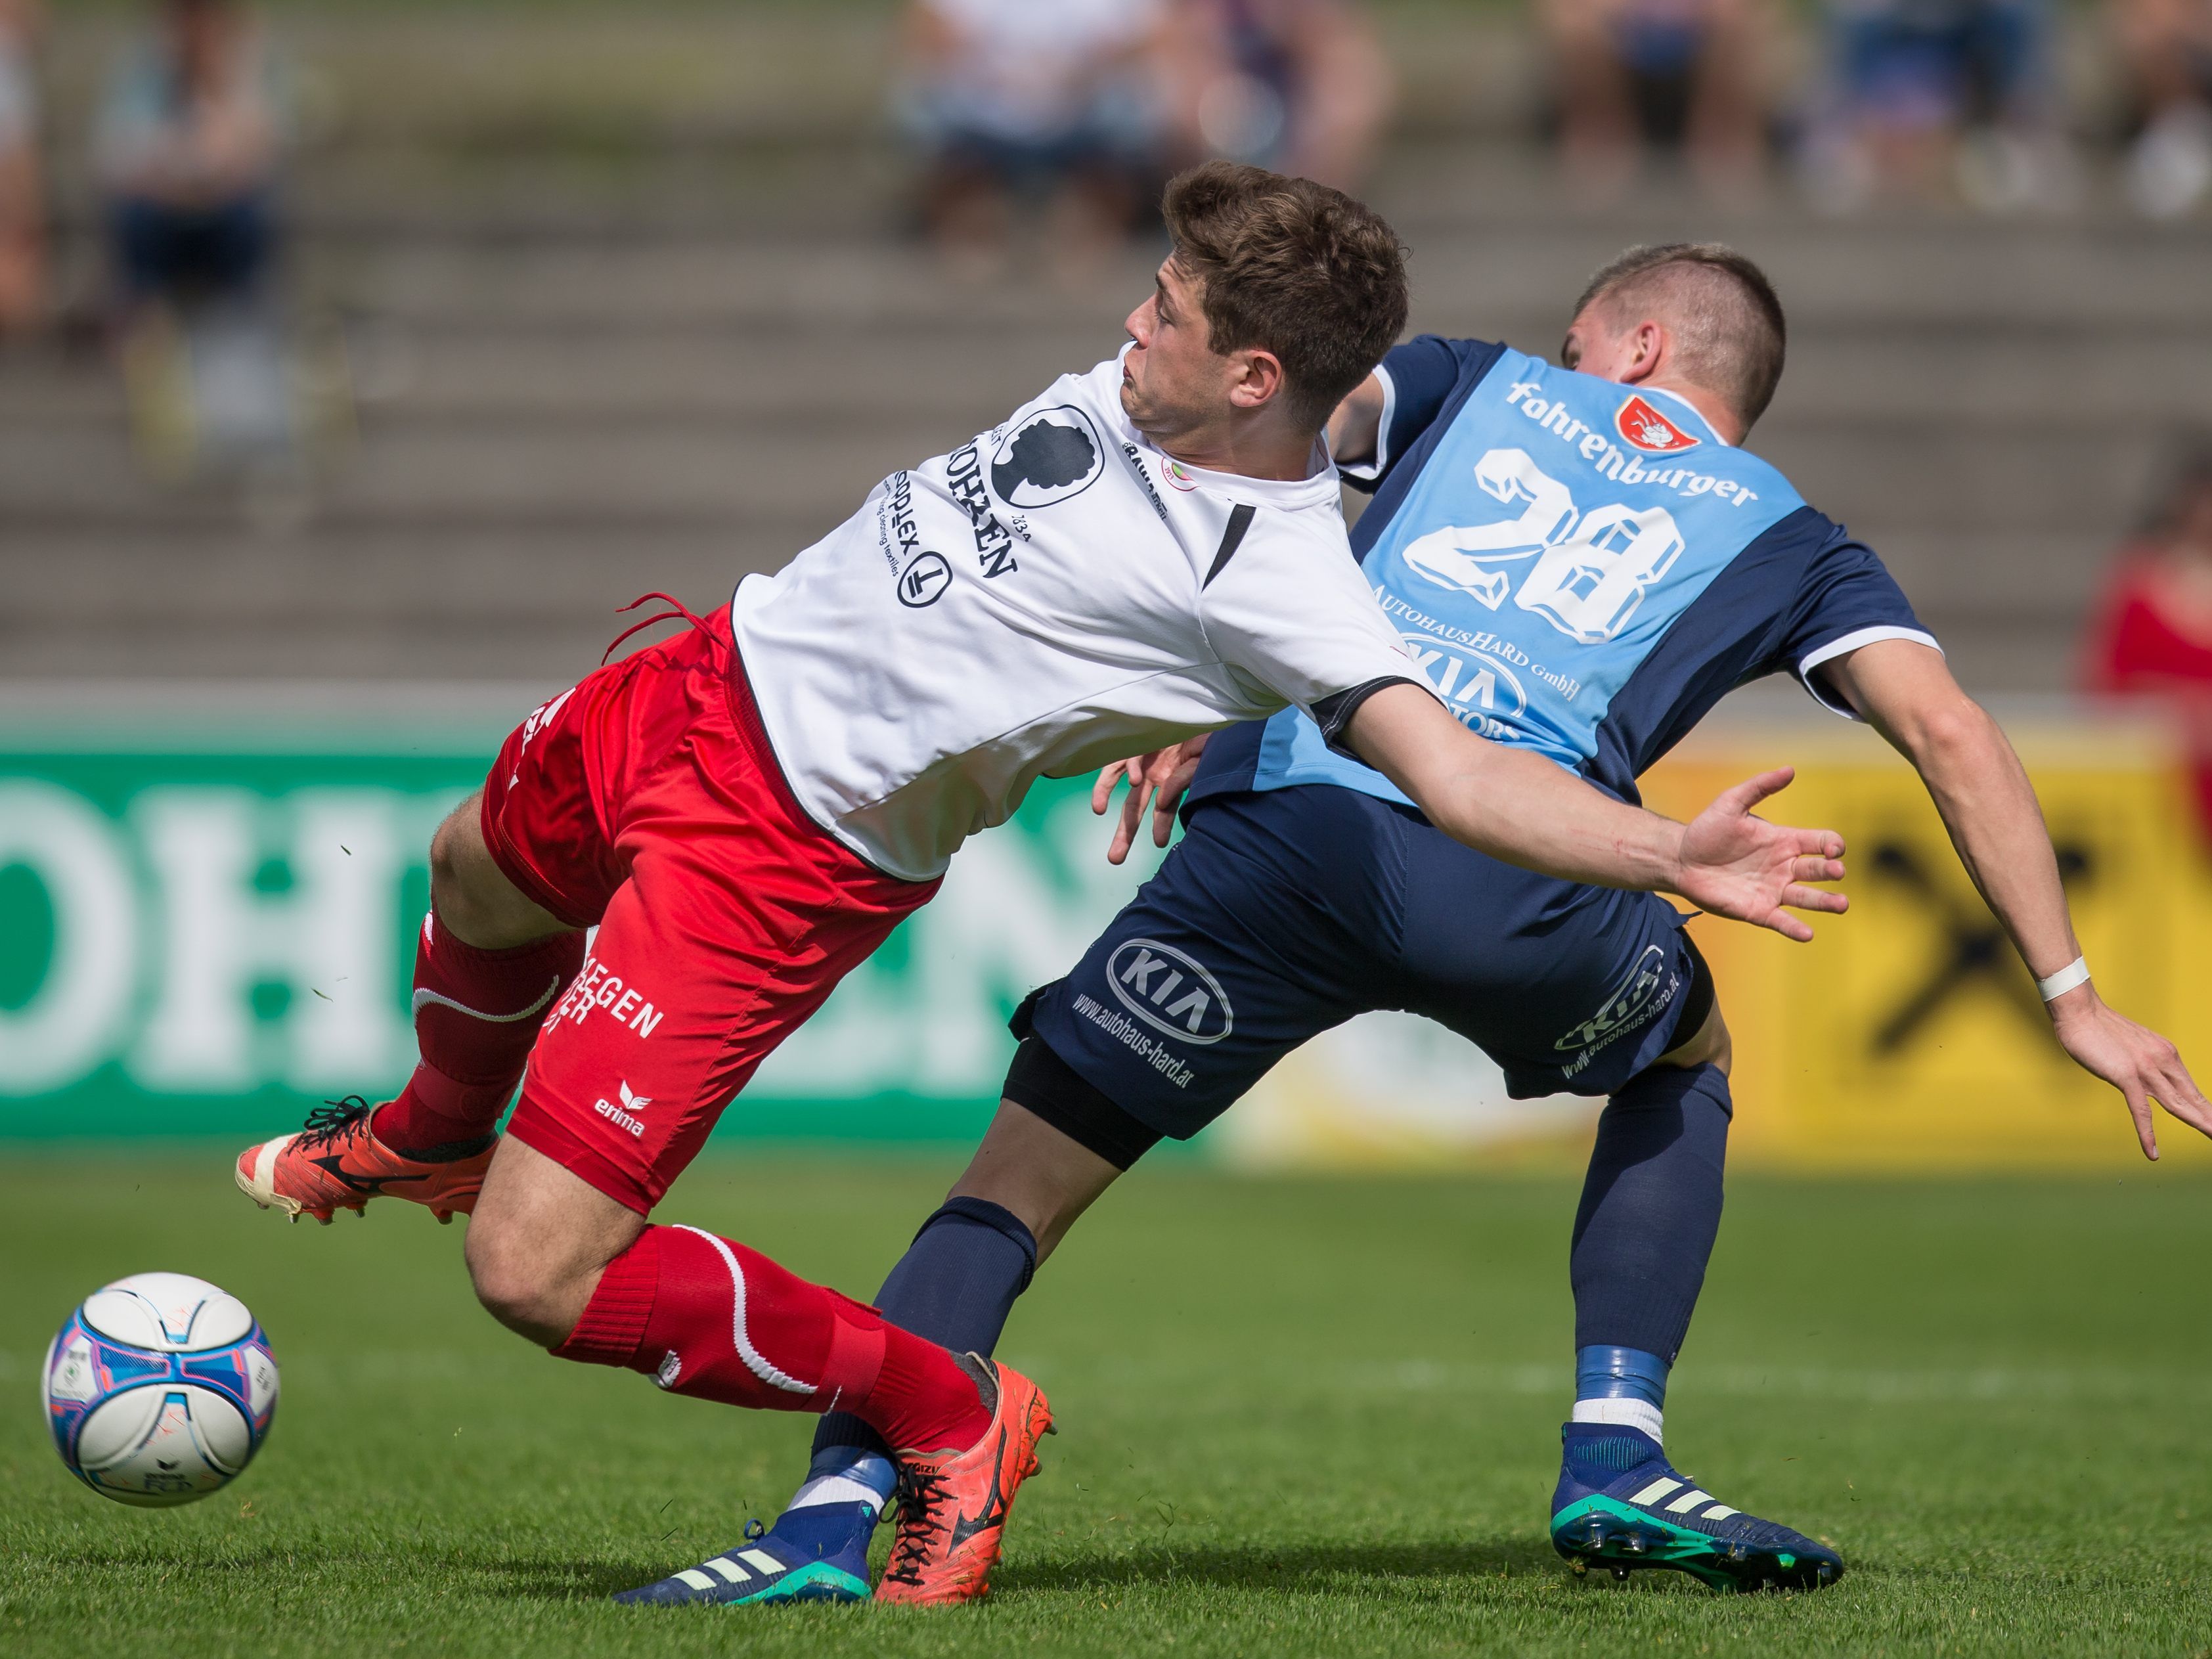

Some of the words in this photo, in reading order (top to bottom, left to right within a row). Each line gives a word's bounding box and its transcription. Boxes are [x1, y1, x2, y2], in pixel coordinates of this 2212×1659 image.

[946, 438, 1018, 579] OHREN
[1402, 448, 1686, 645] 28
[1530, 663, 1582, 703] GmbH
[594, 1098, 645, 1138] erima
